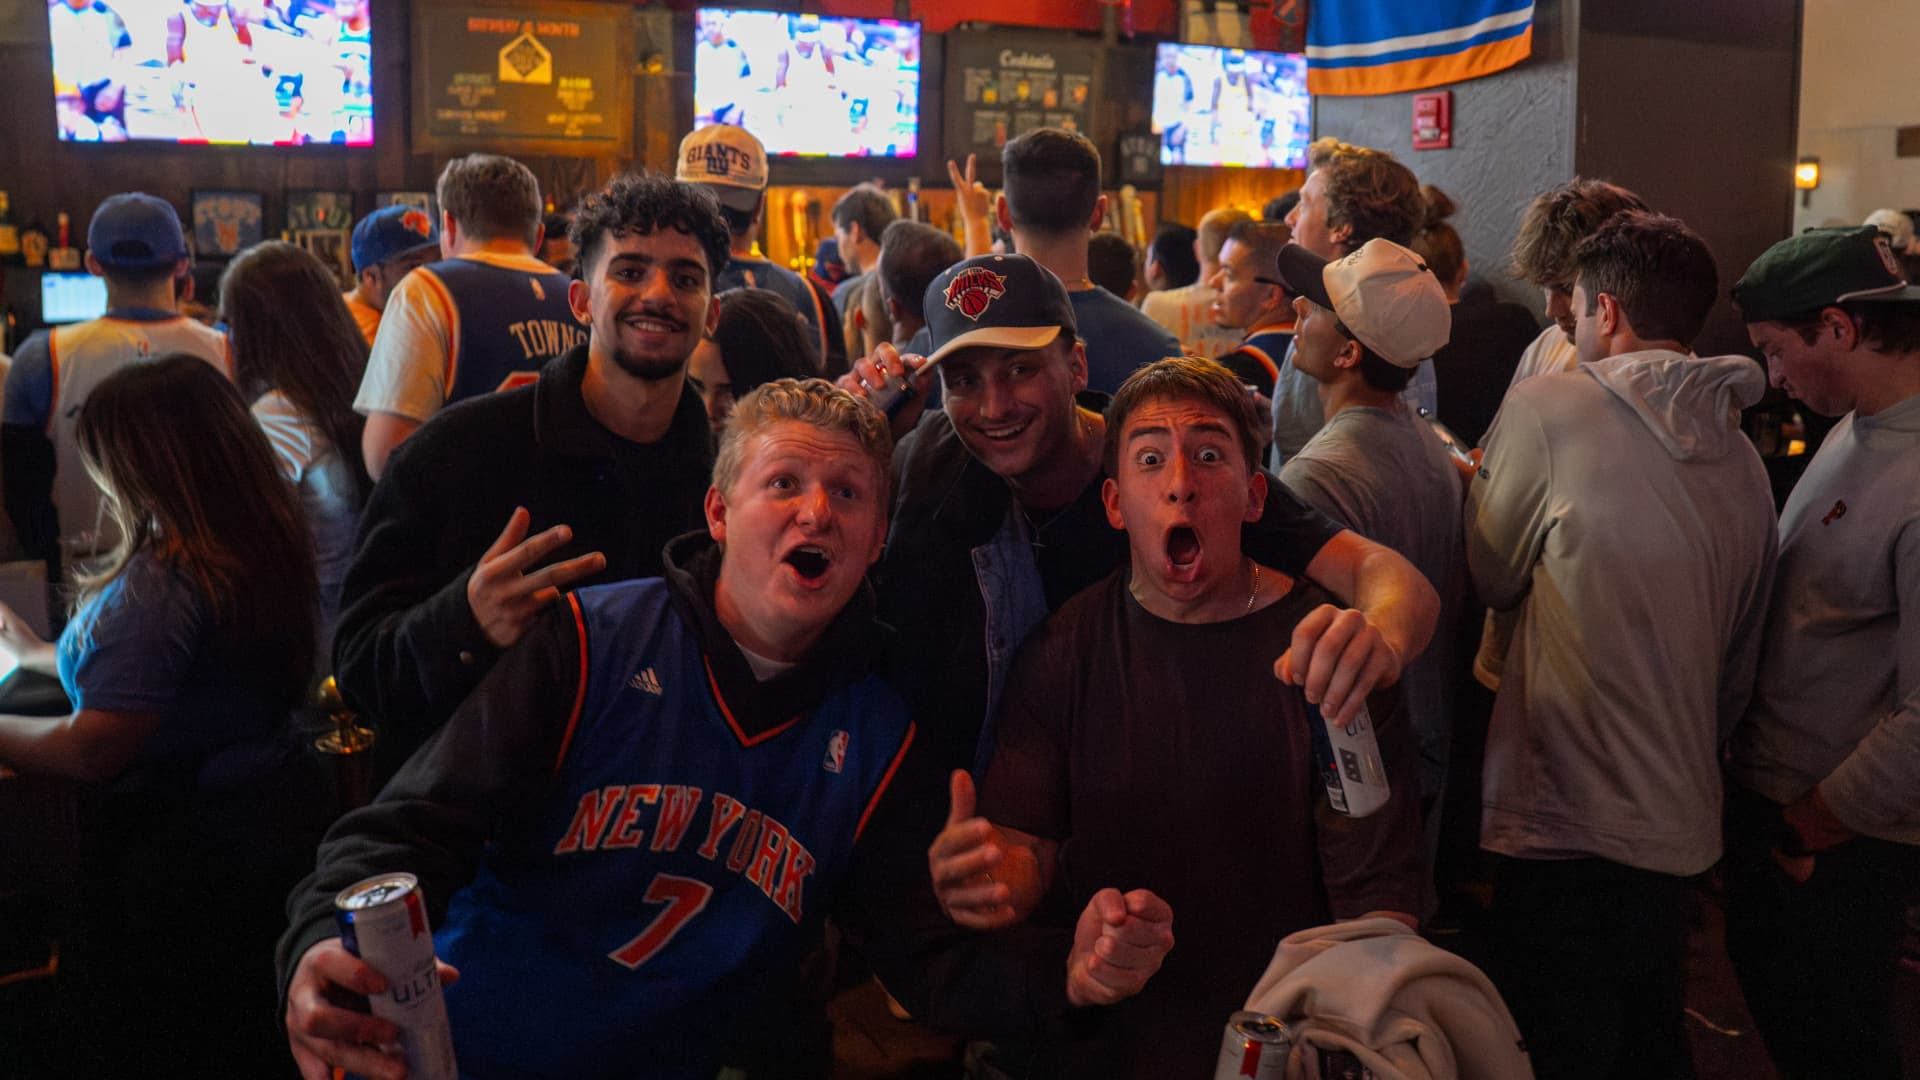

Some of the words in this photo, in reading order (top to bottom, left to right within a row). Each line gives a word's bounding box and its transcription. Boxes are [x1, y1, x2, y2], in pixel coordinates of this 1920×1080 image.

[686, 143, 751, 170] GIANTS
[554, 784, 702, 855] NEW
[697, 792, 816, 924] YORK
[607, 872, 713, 970] 7
